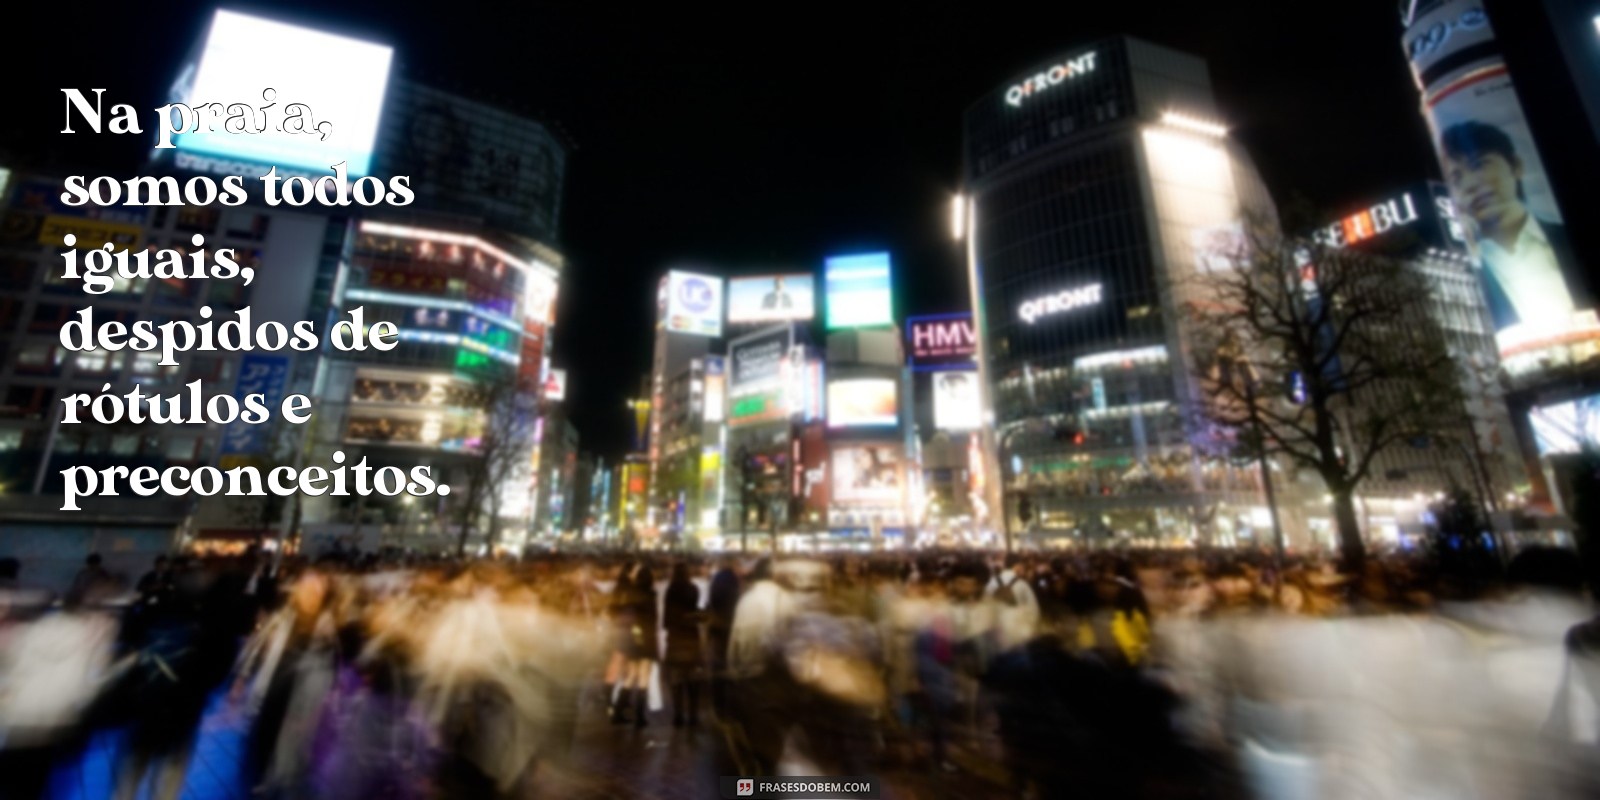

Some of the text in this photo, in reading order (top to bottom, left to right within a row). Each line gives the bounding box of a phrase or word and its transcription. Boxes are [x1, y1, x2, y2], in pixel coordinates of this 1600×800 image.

[1005, 50, 1098, 108] QFRONT
[1311, 191, 1418, 248] SEIBU
[1018, 283, 1103, 325] QFRONT
[913, 319, 977, 349] HMV
